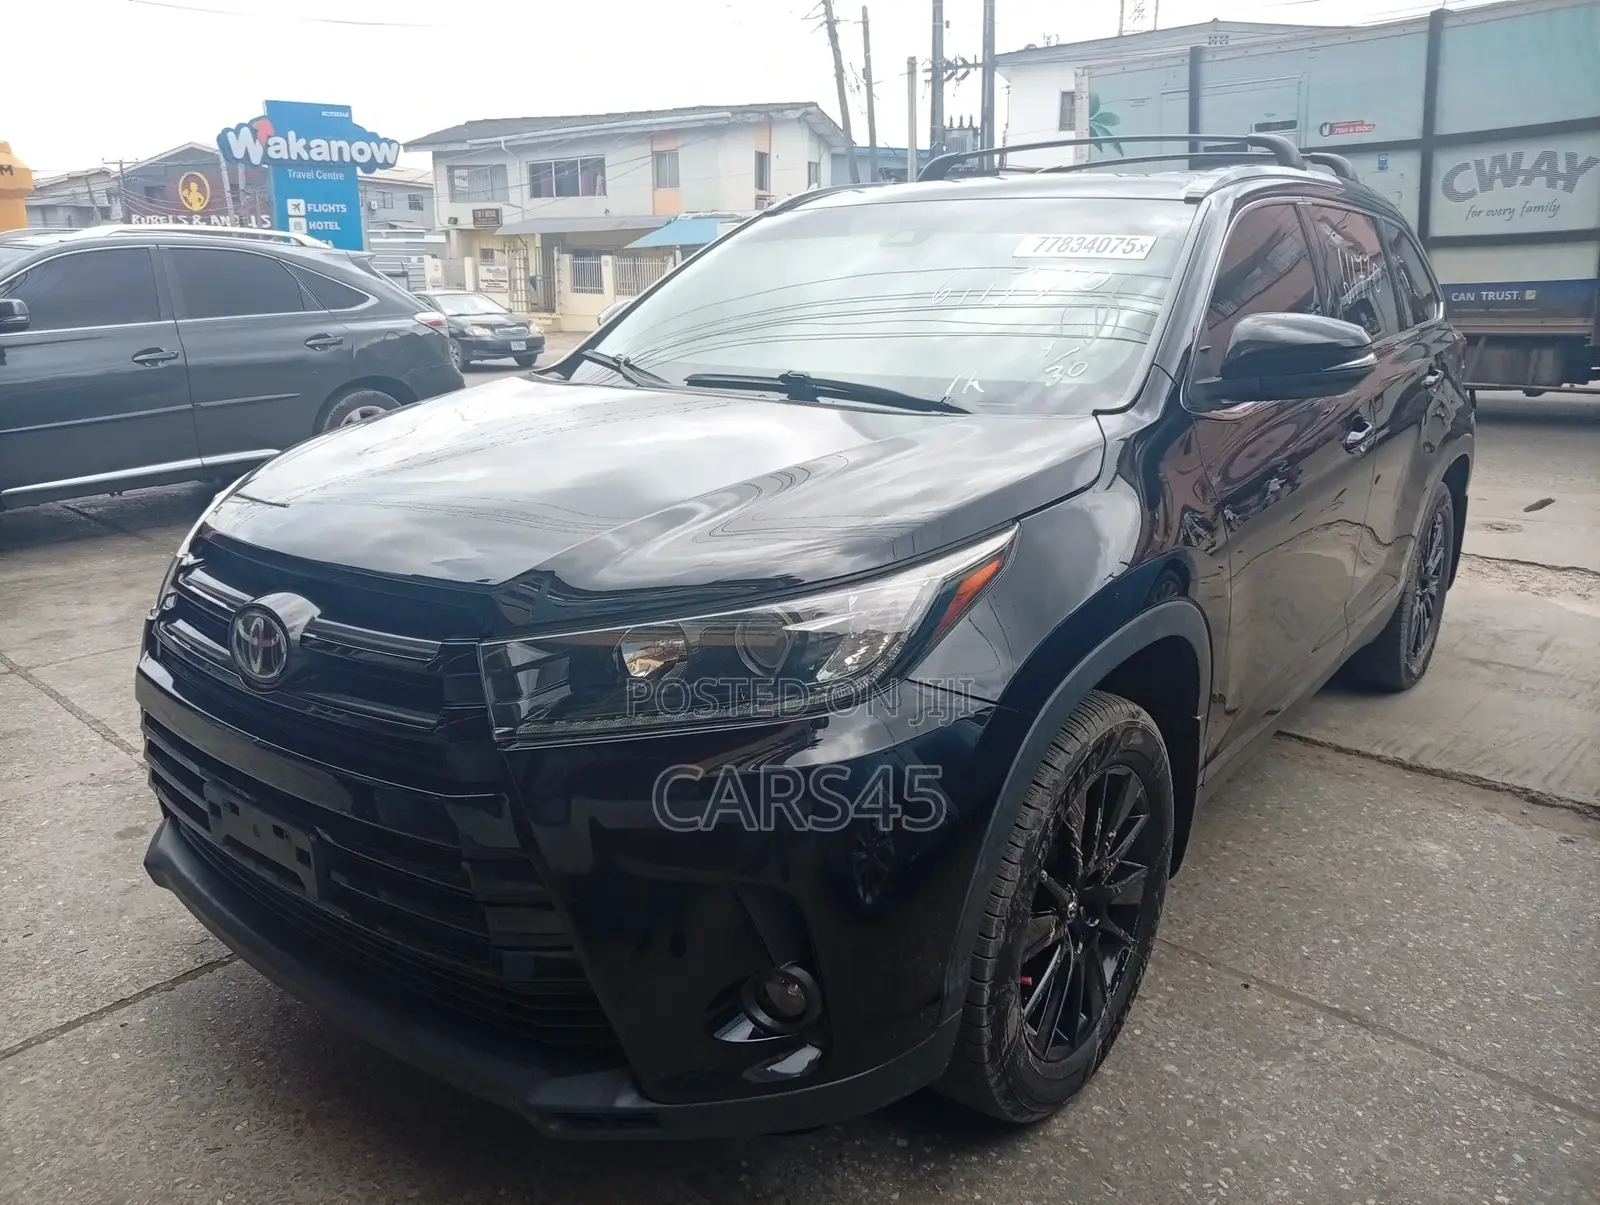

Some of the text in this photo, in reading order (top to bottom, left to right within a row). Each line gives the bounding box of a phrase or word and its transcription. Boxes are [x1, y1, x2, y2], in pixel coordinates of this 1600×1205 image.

[227, 127, 399, 166] Wakanow
[287, 169, 345, 180] Travel Centre
[1441, 150, 1600, 202] CWAY
[307, 203, 347, 213] FLIGHTS
[1465, 199, 1561, 222] for every family
[309, 221, 341, 230] HOTEL
[1451, 290, 1521, 301] CAN TRUST.
